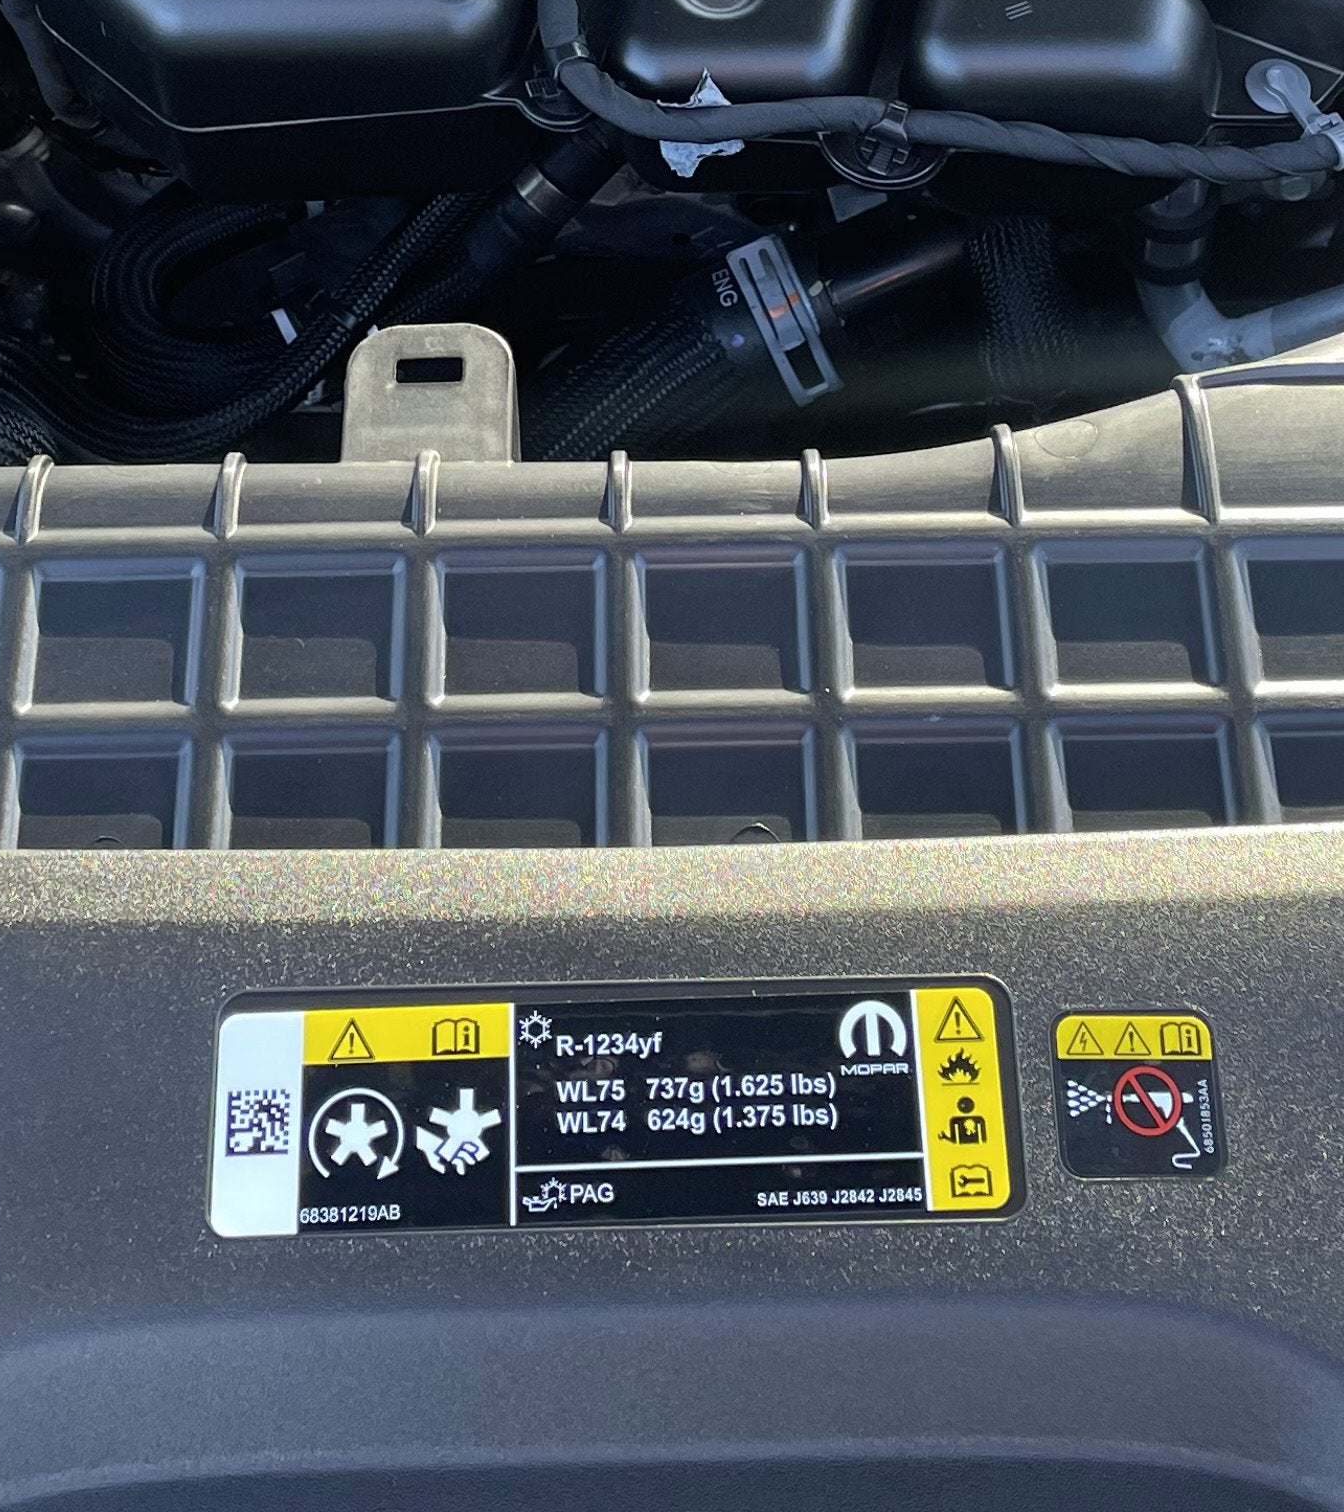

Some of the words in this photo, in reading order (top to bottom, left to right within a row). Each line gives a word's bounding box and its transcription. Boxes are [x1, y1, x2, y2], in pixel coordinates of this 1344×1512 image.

[711, 268, 739, 308] ENG
[556, 1031, 663, 1058] R-1234yf
[840, 1062, 909, 1076] MOPAR
[556, 1079, 626, 1103] WL75
[646, 1076, 705, 1104] 737g
[711, 1073, 784, 1102] (1.625
[791, 1071, 837, 1099] lbs)
[557, 1109, 627, 1134] WL74
[647, 1107, 706, 1135] 624g
[713, 1104, 786, 1134] (1.375
[792, 1102, 838, 1130] lbs)
[1197, 1078, 1215, 1154] 68501853AA
[569, 1183, 614, 1204] PAG
[757, 1190, 789, 1207] SAE
[792, 1189, 828, 1206] J639
[831, 1188, 875, 1205] J2842
[878, 1187, 923, 1204] J2845
[299, 1204, 401, 1224] 68381219AB
